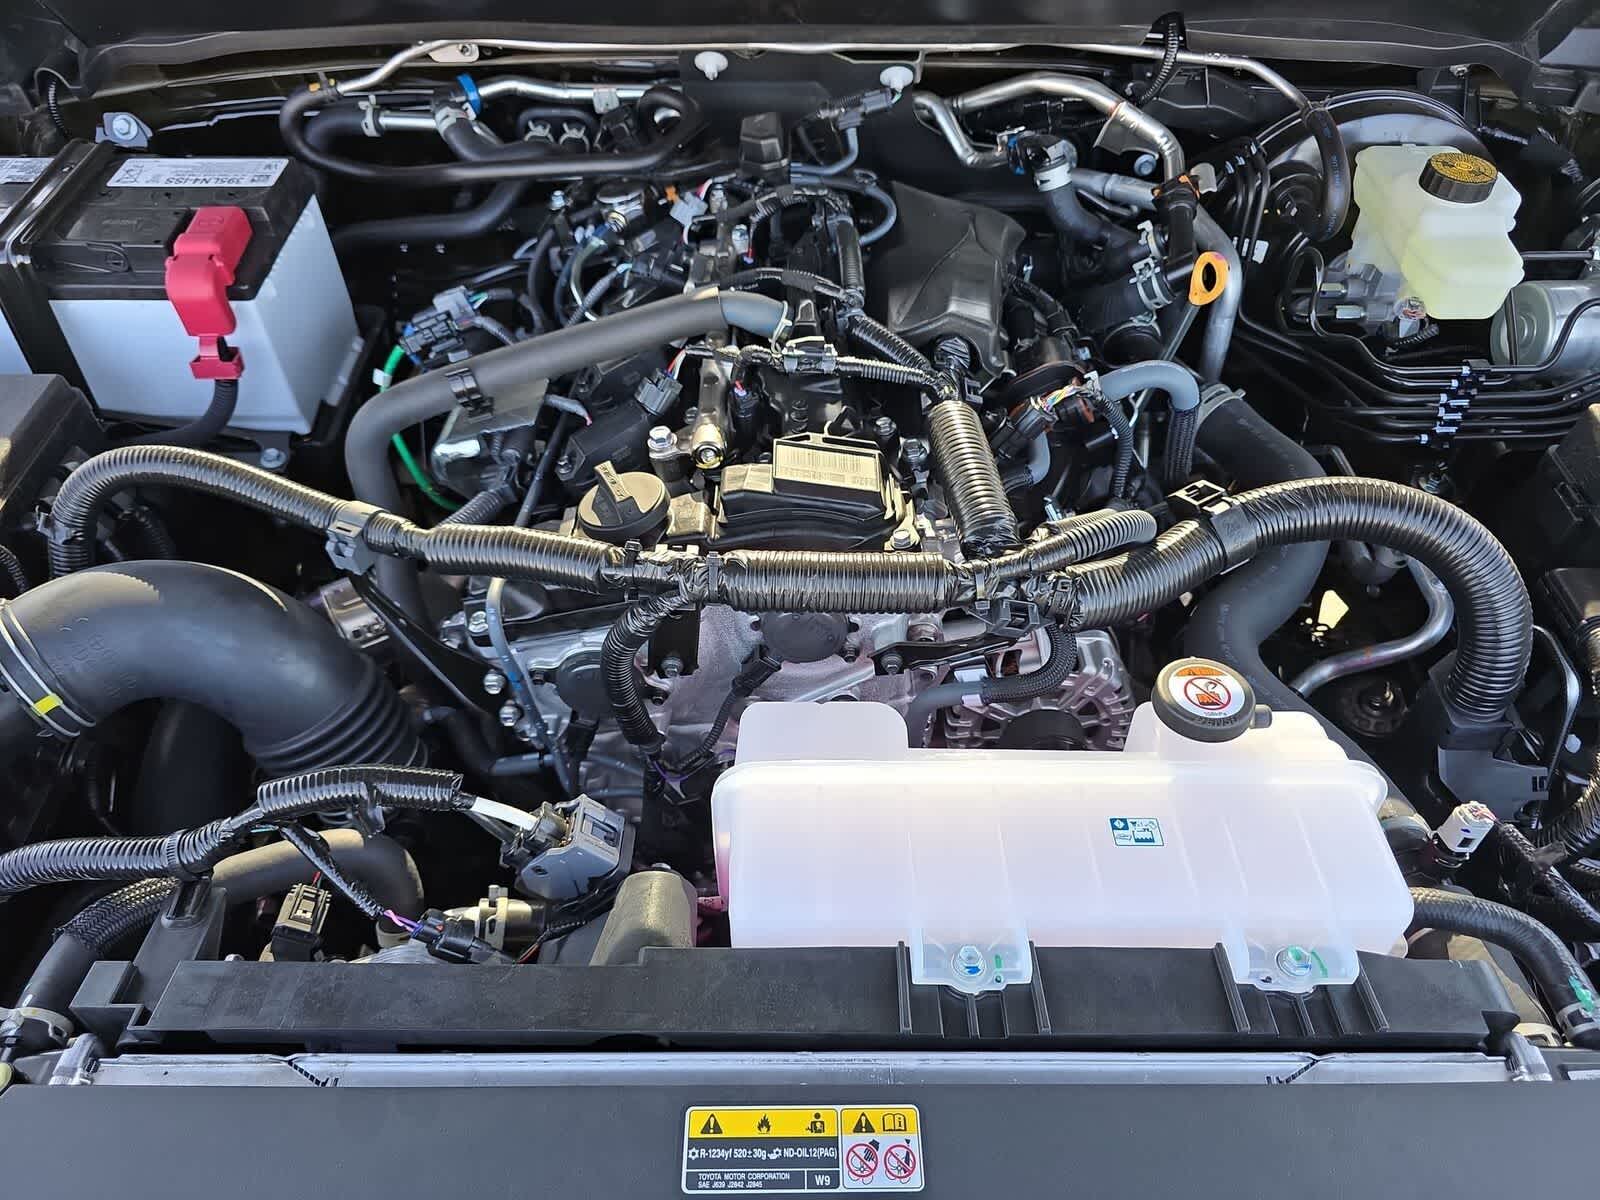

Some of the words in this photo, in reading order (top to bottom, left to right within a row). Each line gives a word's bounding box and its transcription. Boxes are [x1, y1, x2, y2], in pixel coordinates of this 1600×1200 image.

[700, 1148, 732, 1161] R-1234yf
[733, 1148, 767, 1161] 520±30g
[783, 1147, 837, 1159] ND-OIL12(PAG)
[698, 1173, 722, 1181] TOYOTA
[747, 1172, 790, 1180] CORPORATION
[814, 1174, 831, 1186] W9
